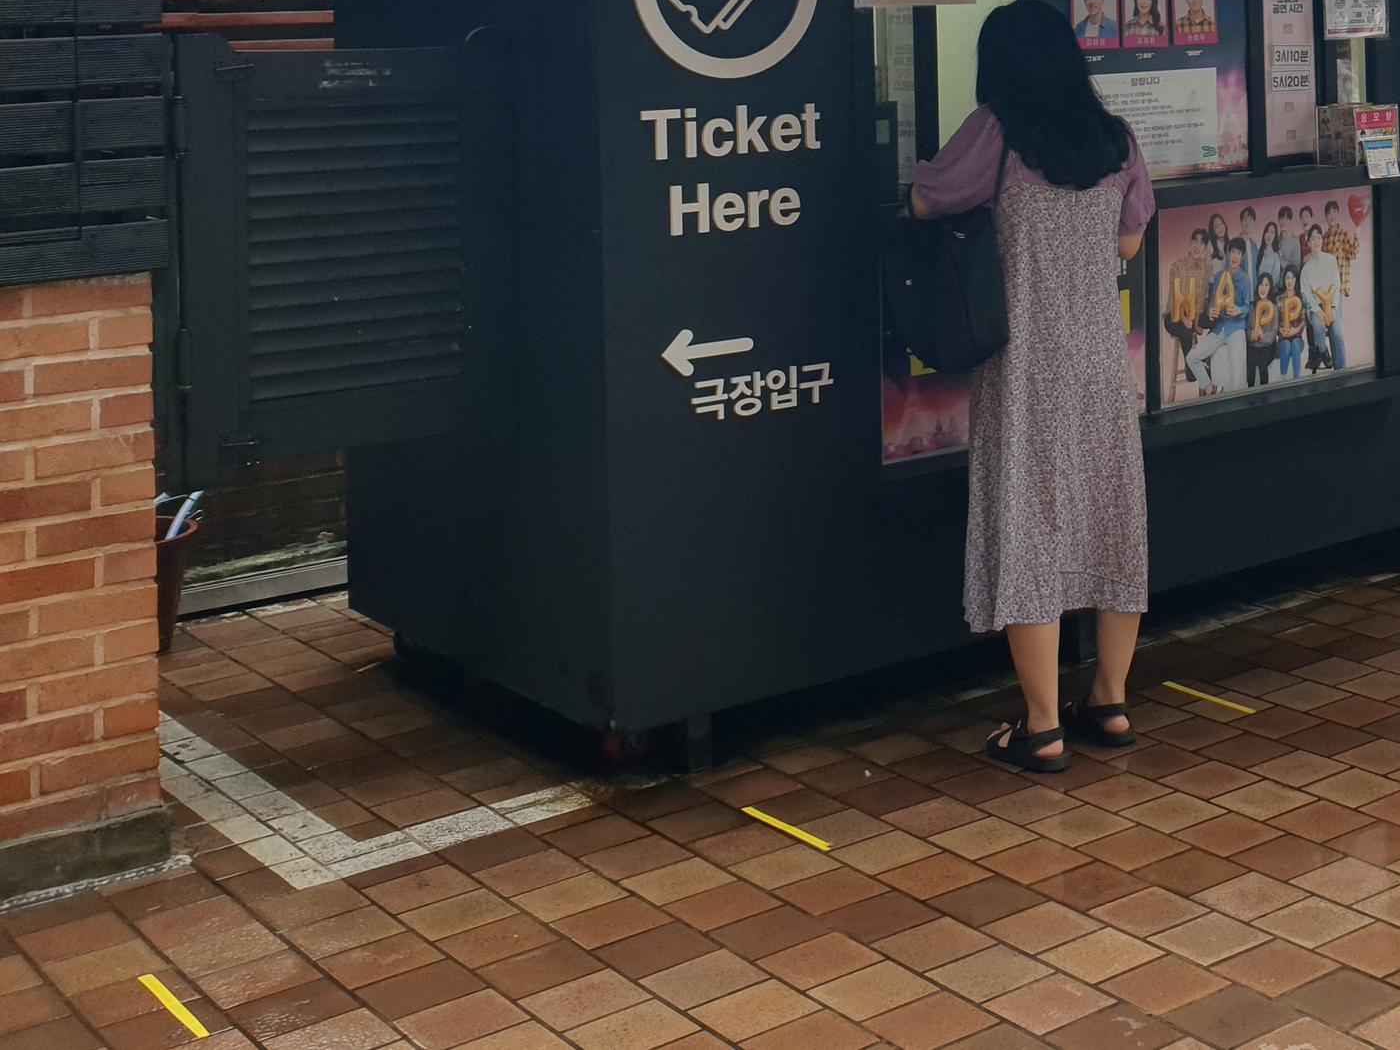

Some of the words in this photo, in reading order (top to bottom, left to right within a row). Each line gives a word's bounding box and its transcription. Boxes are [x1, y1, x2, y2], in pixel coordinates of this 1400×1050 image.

[1272, 4, 1287, 14] 공연
[1288, 4, 1303, 13] 시간
[1273, 75, 1308, 87] 5시20분
[1275, 50, 1308, 62] 3시10분
[640, 103, 821, 160] Ticket
[669, 183, 801, 236] Here
[1172, 271, 1336, 341] HAPPY
[691, 362, 834, 420] 극장입구
